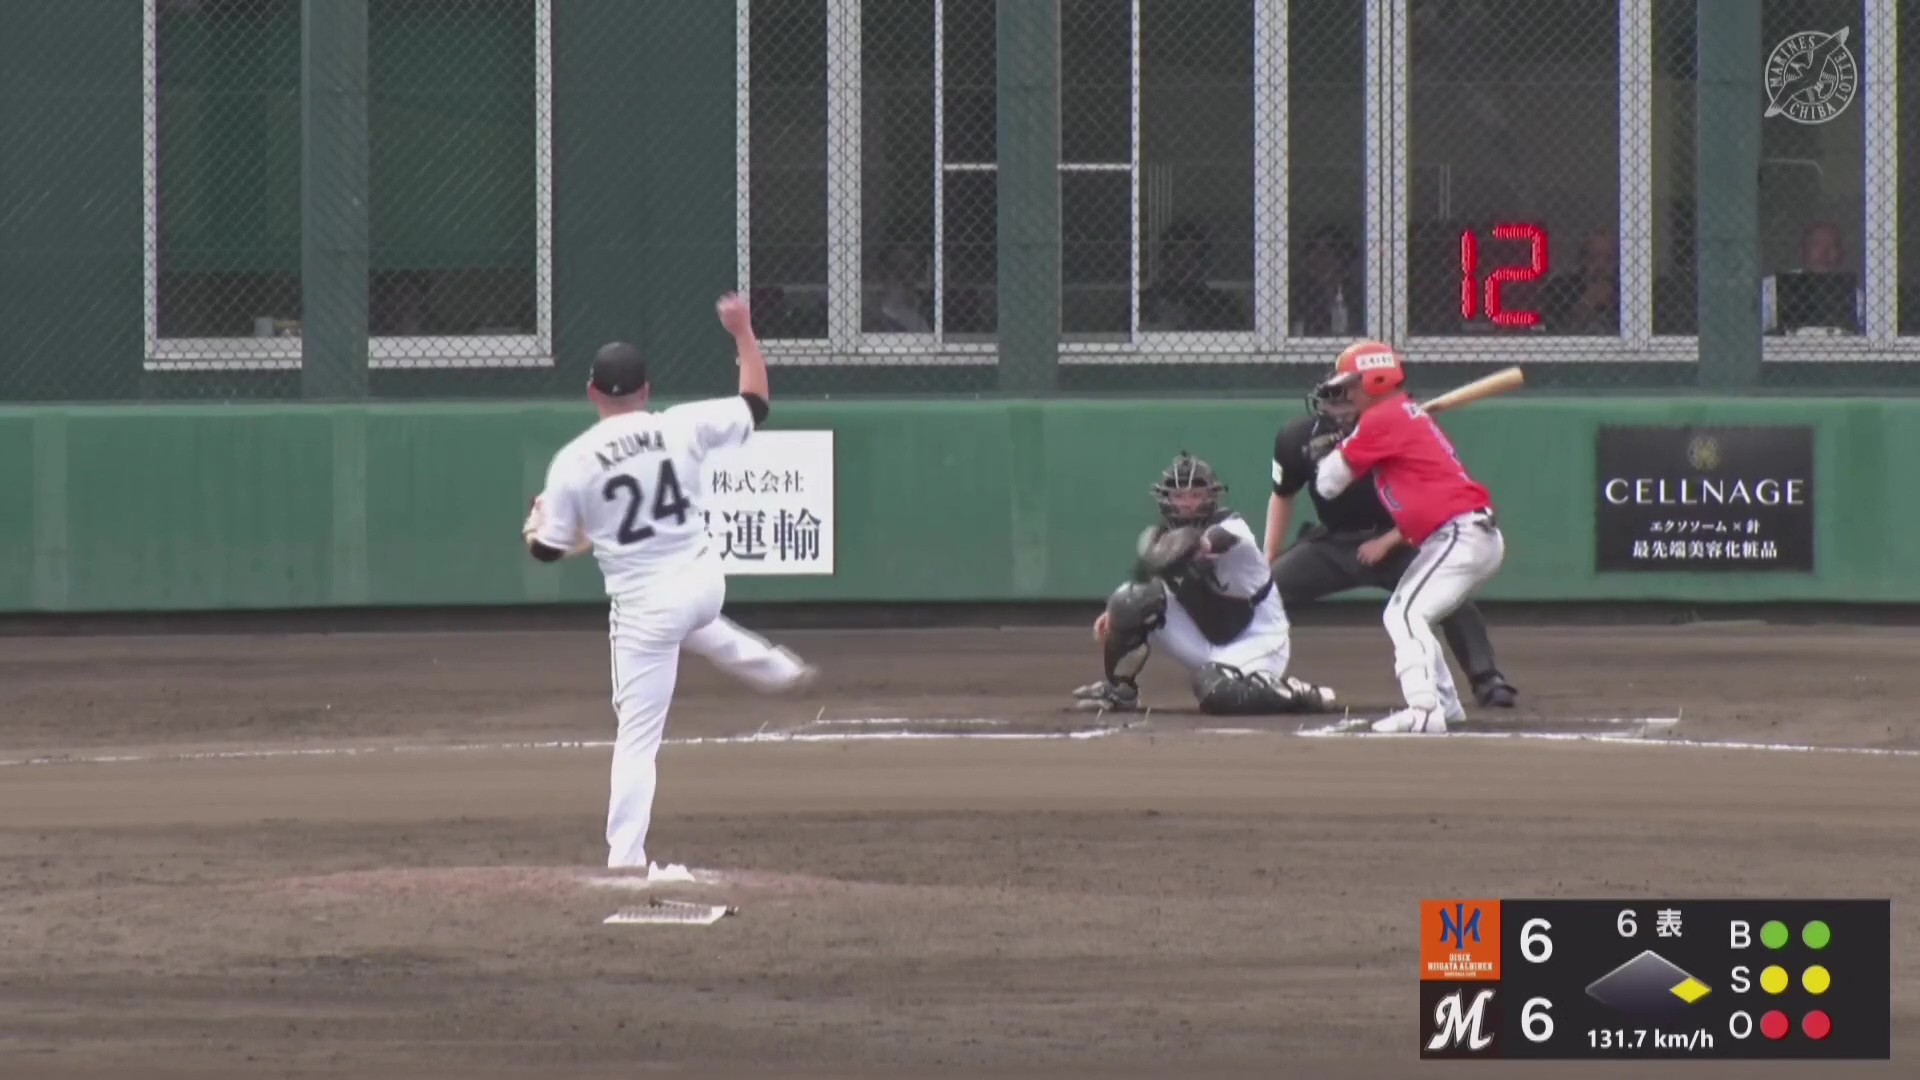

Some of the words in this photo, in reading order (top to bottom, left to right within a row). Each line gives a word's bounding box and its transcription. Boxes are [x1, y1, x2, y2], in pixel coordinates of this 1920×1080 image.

[1461, 225, 1548, 326] 12
[595, 429, 667, 472] AZUMA
[712, 469, 805, 494] 株式会社
[1605, 478, 1804, 505] CELLNAGE
[602, 458, 691, 545] 24
[1633, 540, 1777, 559] 最先端美容化粧品
